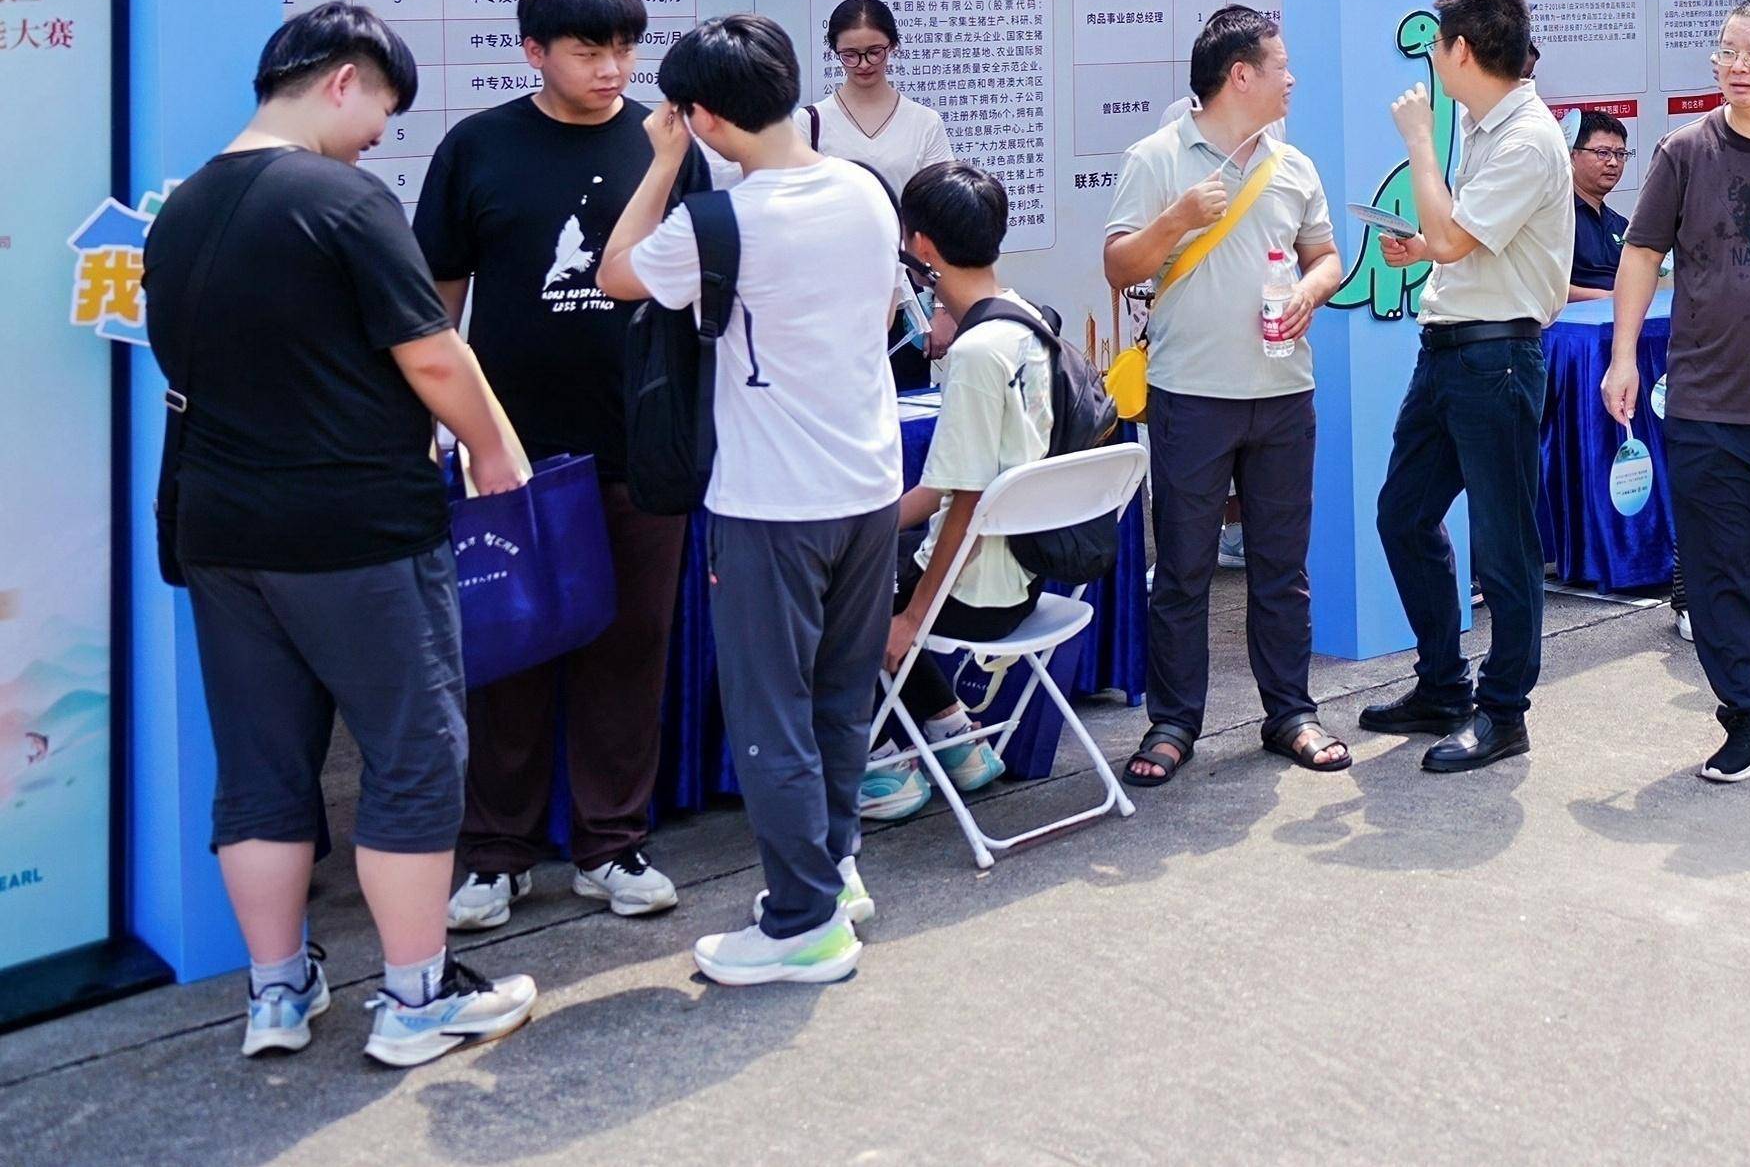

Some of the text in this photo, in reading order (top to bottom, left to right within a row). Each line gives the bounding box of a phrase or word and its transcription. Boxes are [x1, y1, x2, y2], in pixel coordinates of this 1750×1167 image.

[1087, 12, 1163, 24] 肉品事业部总经理
[0, 18, 75, 50] 大赛
[471, 76, 543, 90] 中专及以上
[1103, 101, 1150, 114] 兽医技术官
[396, 129, 404, 141] 5
[397, 175, 405, 186] 5
[988, 168, 1044, 182] 现生猪上市
